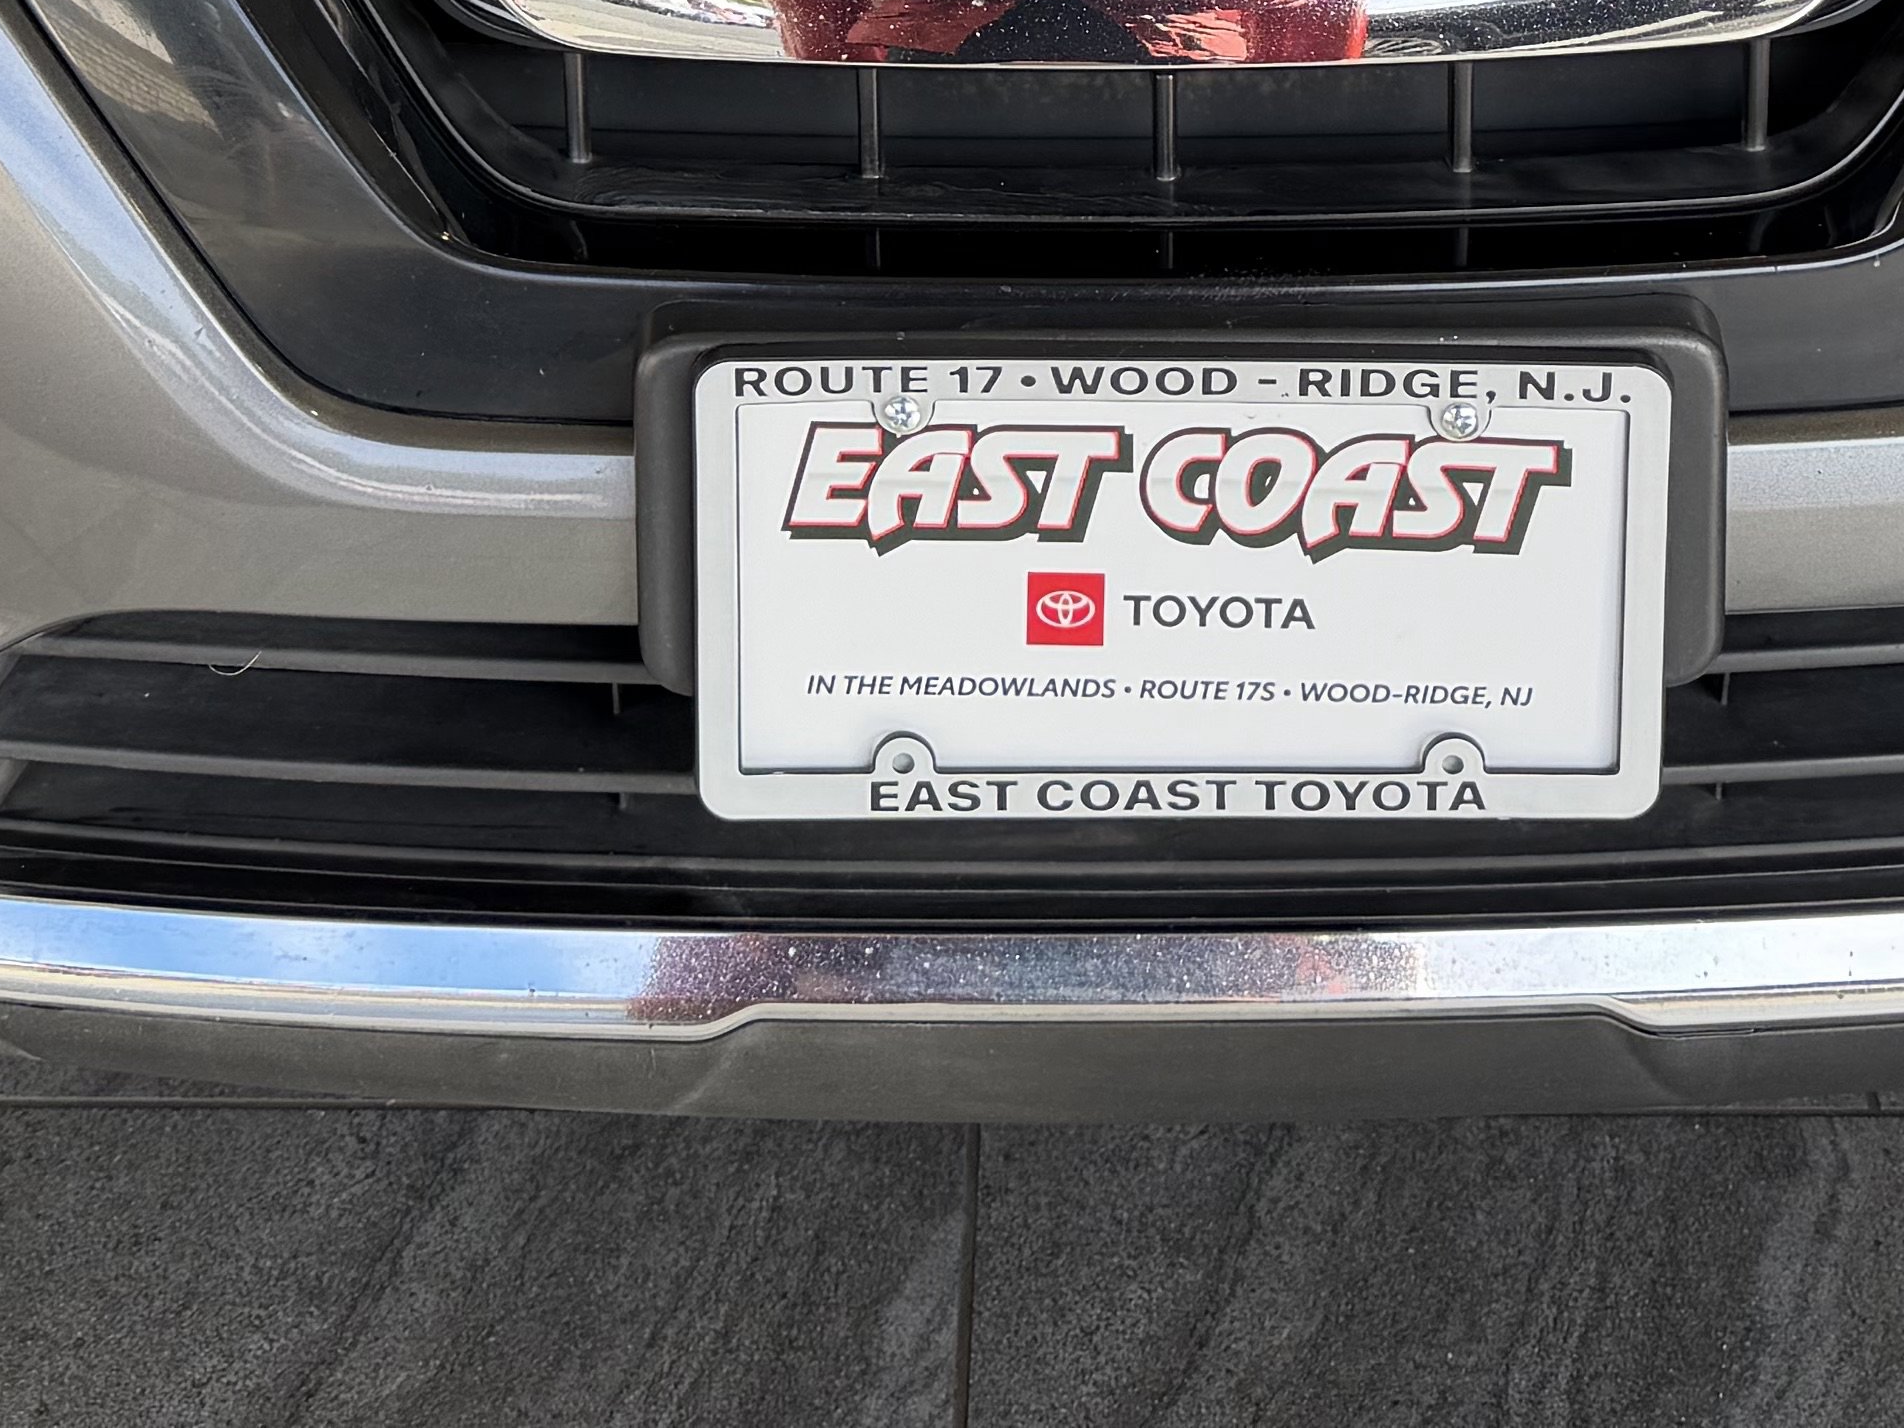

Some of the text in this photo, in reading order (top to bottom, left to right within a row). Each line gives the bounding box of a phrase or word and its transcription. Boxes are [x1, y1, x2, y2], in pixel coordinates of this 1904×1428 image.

[734, 366, 929, 397] ROUTE
[949, 366, 1004, 394] 17
[1050, 365, 1238, 396] WOOD
[1298, 369, 1496, 404] RIDGE,
[1518, 370, 1632, 404] N.J.
[781, 421, 1573, 565] EAST COAST
[1122, 594, 1316, 631] TOYOTA
[807, 674, 1534, 710] IN THE MEADOWLANDS ROUTE 17S WOOD-RIDGE, NJ
[869, 779, 1487, 812] EAST COAST TOYOTA
